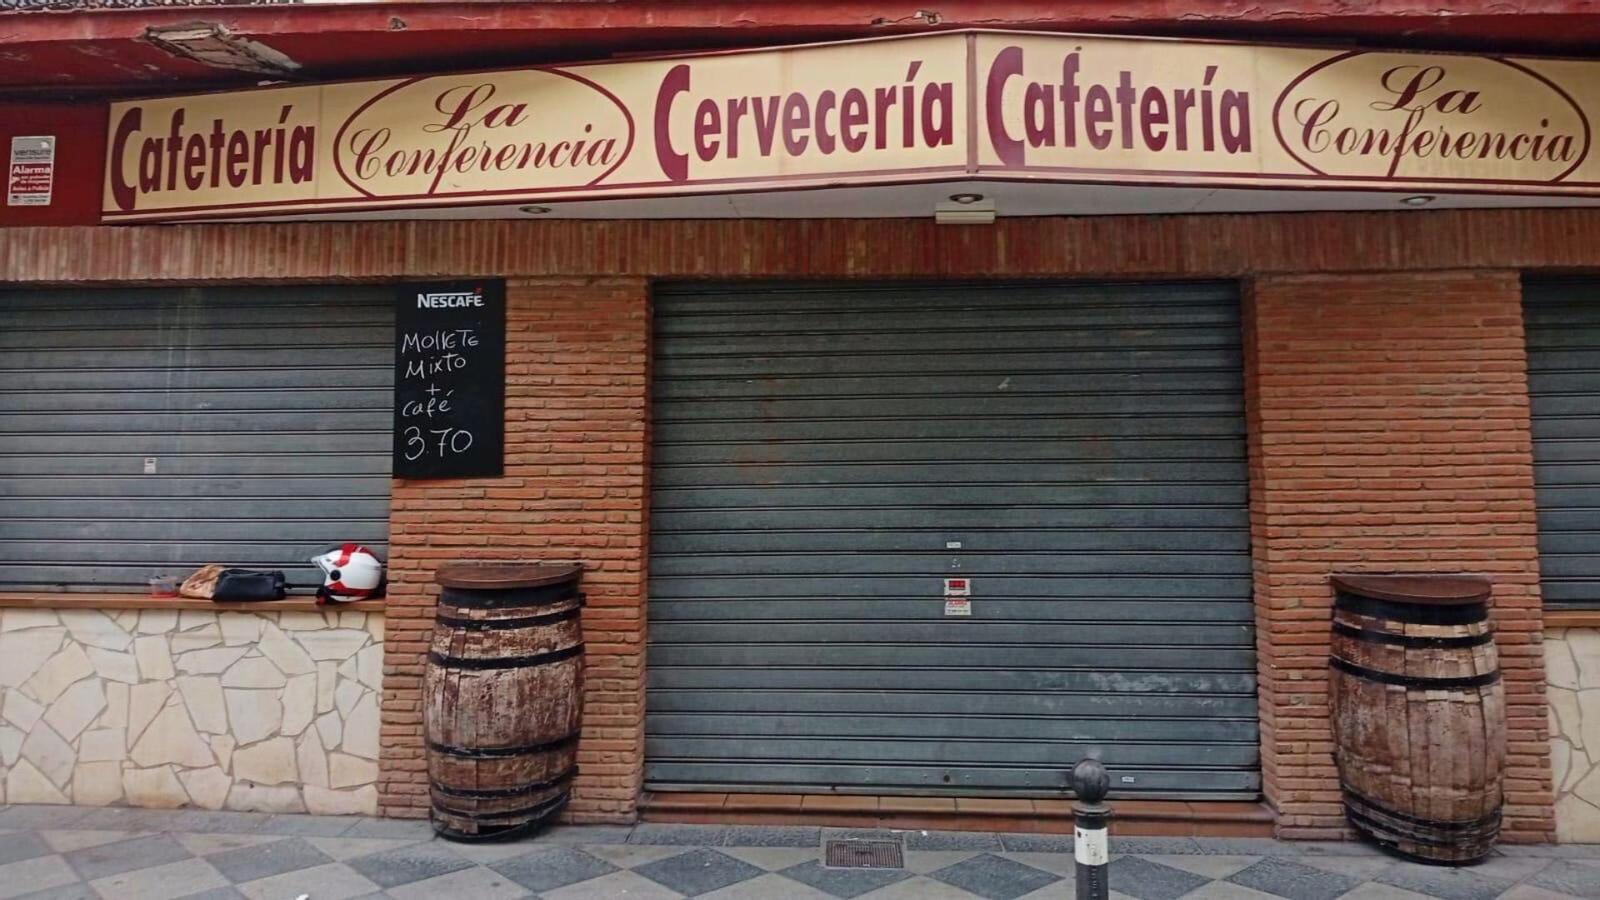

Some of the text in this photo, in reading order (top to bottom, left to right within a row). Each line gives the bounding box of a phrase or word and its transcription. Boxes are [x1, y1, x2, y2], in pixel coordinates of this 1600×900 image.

[424, 83, 530, 132] La
[986, 46, 1251, 166] Cafetería
[1370, 65, 1483, 114] La
[655, 61, 953, 181] Cervecería
[1294, 98, 1577, 177] Conferencia
[13, 165, 50, 174] Alarma
[111, 104, 314, 210] Cafetería
[349, 123, 618, 195] Conferencia
[417, 288, 485, 308] NESCAFÉ
[425, 383, 441, 397] +
[404, 426, 473, 461] 3.70
